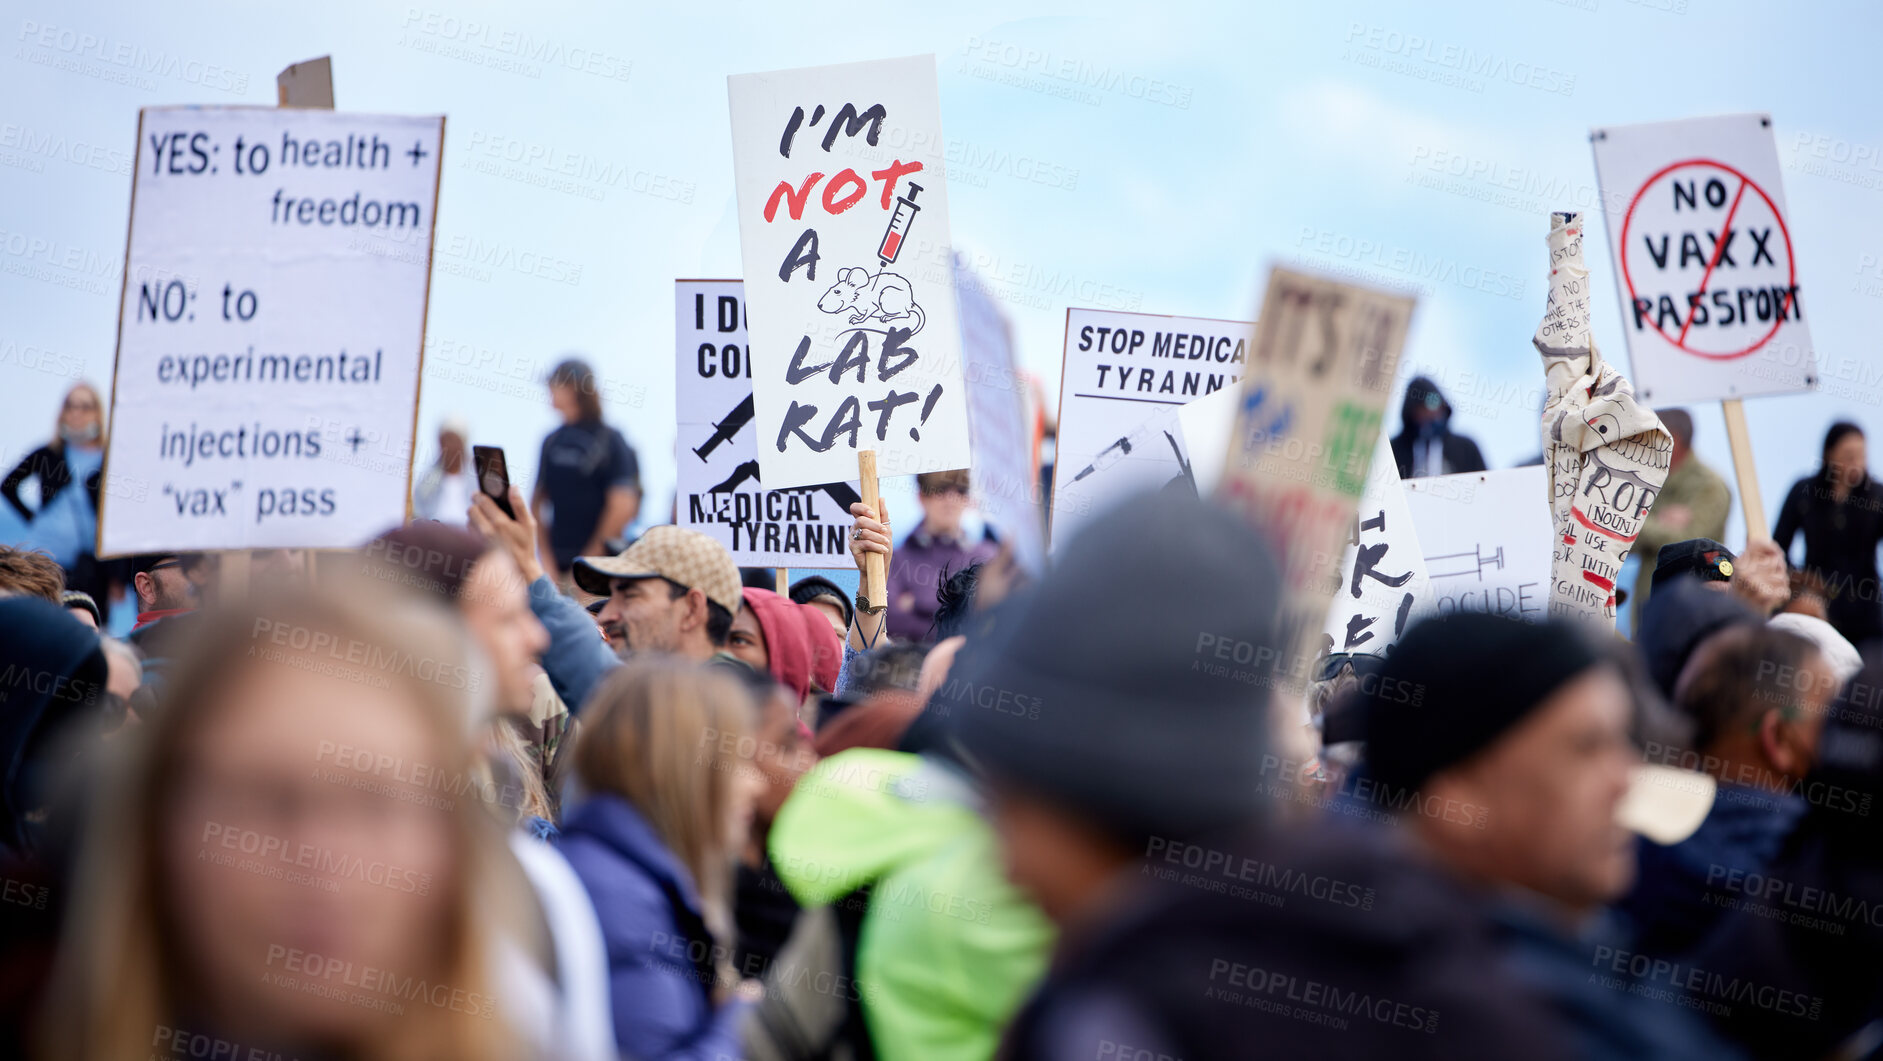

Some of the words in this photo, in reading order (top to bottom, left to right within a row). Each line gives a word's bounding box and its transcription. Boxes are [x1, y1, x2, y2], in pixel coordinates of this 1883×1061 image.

[779, 103, 887, 158] I'M
[150, 132, 220, 175] YES:
[234, 135, 270, 175] to
[281, 131, 390, 169] health
[271, 188, 421, 227] freedom
[763, 159, 925, 224] NOT
[1672, 177, 1728, 211] NO
[778, 228, 821, 282] A
[138, 280, 197, 322] NO:
[222, 282, 258, 321] to
[695, 293, 704, 330] I
[718, 295, 747, 333] D
[1631, 284, 1802, 331] PASSPORT
[785, 326, 920, 384] LAB
[1078, 325, 1145, 355] STOP
[1152, 332, 1252, 365] MEDICA
[157, 345, 383, 389] experimental
[776, 383, 944, 453] RAT!
[160, 422, 321, 467] injections
[256, 486, 336, 523] pass
[689, 491, 820, 523] MEDICAL
[729, 521, 848, 555] TYRANN
[1584, 531, 1609, 552] USE
